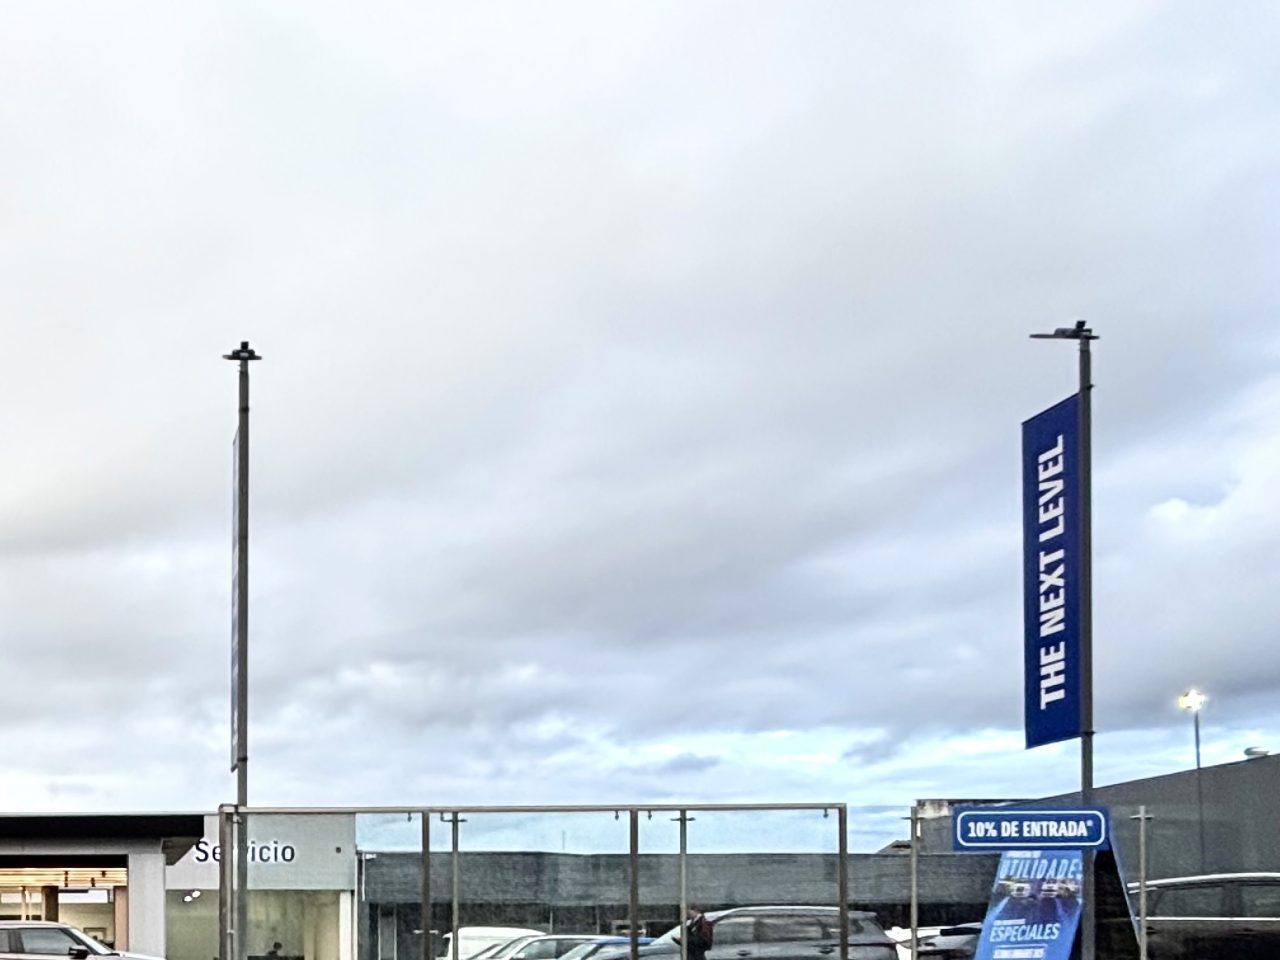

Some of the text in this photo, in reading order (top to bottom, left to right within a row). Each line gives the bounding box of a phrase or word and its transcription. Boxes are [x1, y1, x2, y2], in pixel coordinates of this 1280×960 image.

[1038, 434, 1066, 711] THE NEXT LEVEL
[968, 822, 997, 838] 10%
[1001, 822, 1020, 838] DE
[195, 840, 295, 863] Seicio
[989, 923, 1061, 942] ESPECIALES
